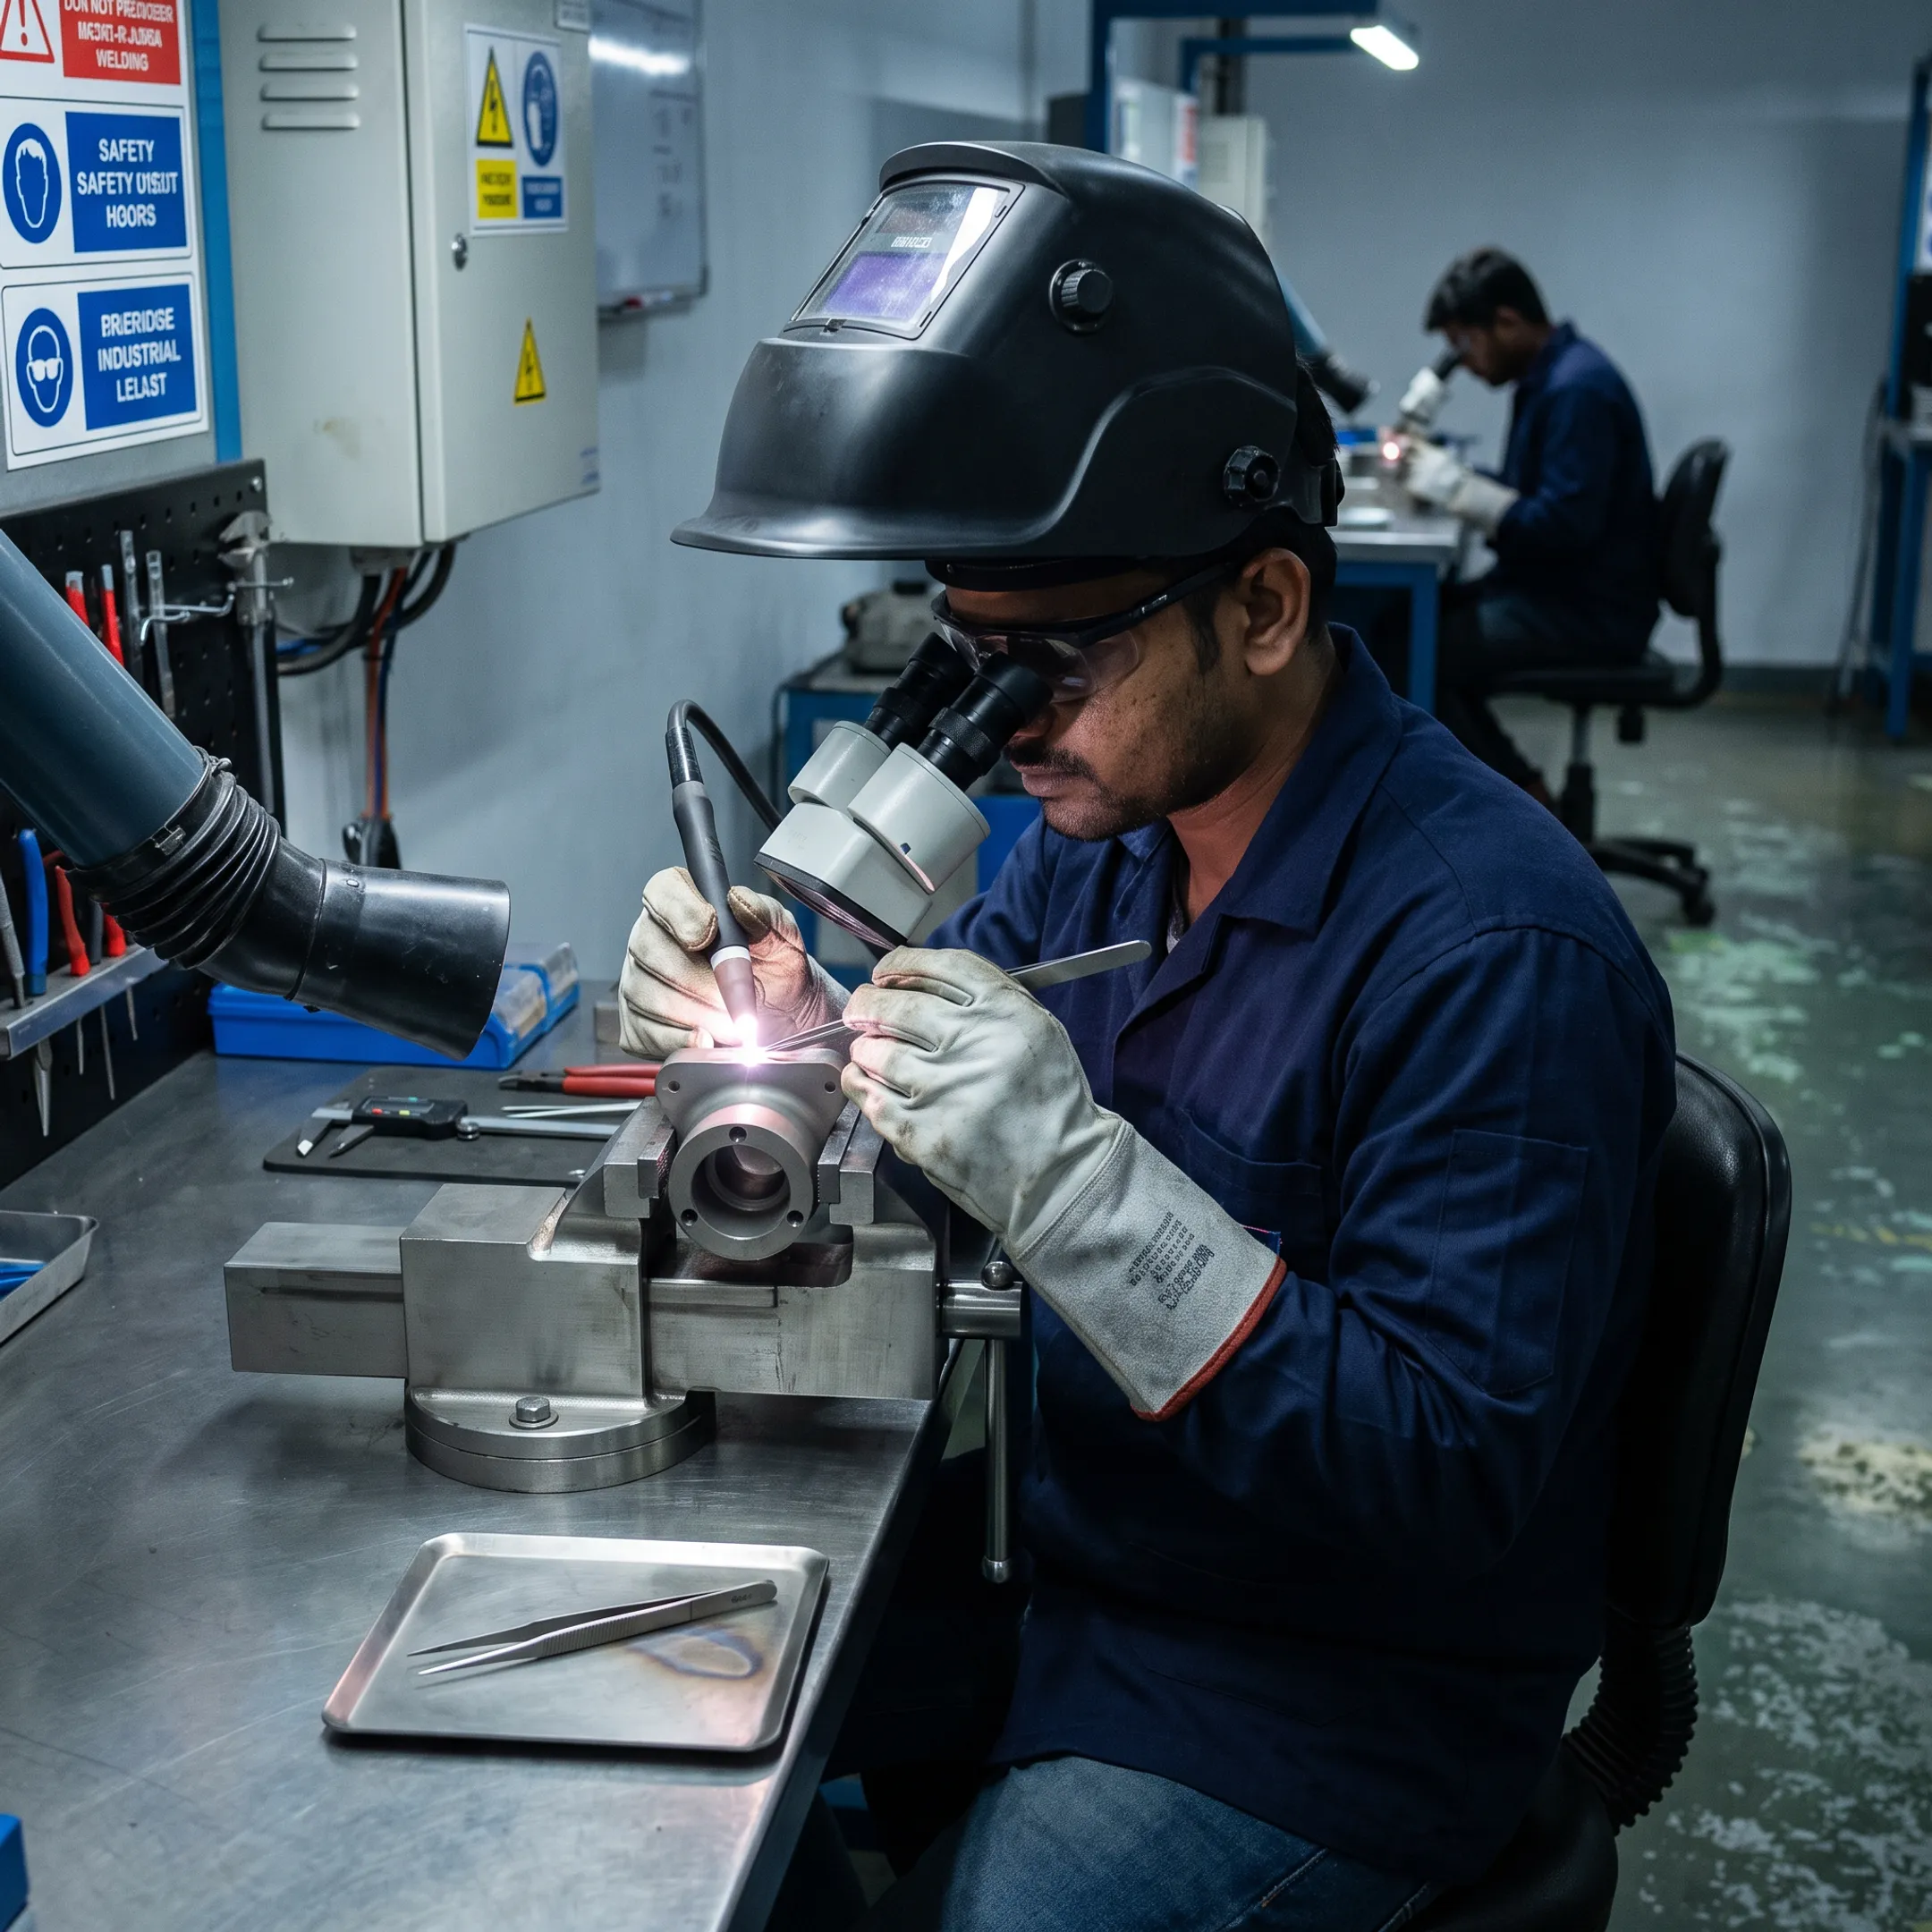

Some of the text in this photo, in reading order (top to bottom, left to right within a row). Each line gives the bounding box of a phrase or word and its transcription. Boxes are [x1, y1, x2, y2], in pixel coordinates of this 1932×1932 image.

[96, 48, 149, 72] WELDING
[98, 138, 155, 163] SAFETY
[77, 171, 133, 195] SAFETY
[97, 339, 182, 372] INDUSTRIAL
[116, 372, 167, 402] LELAST
